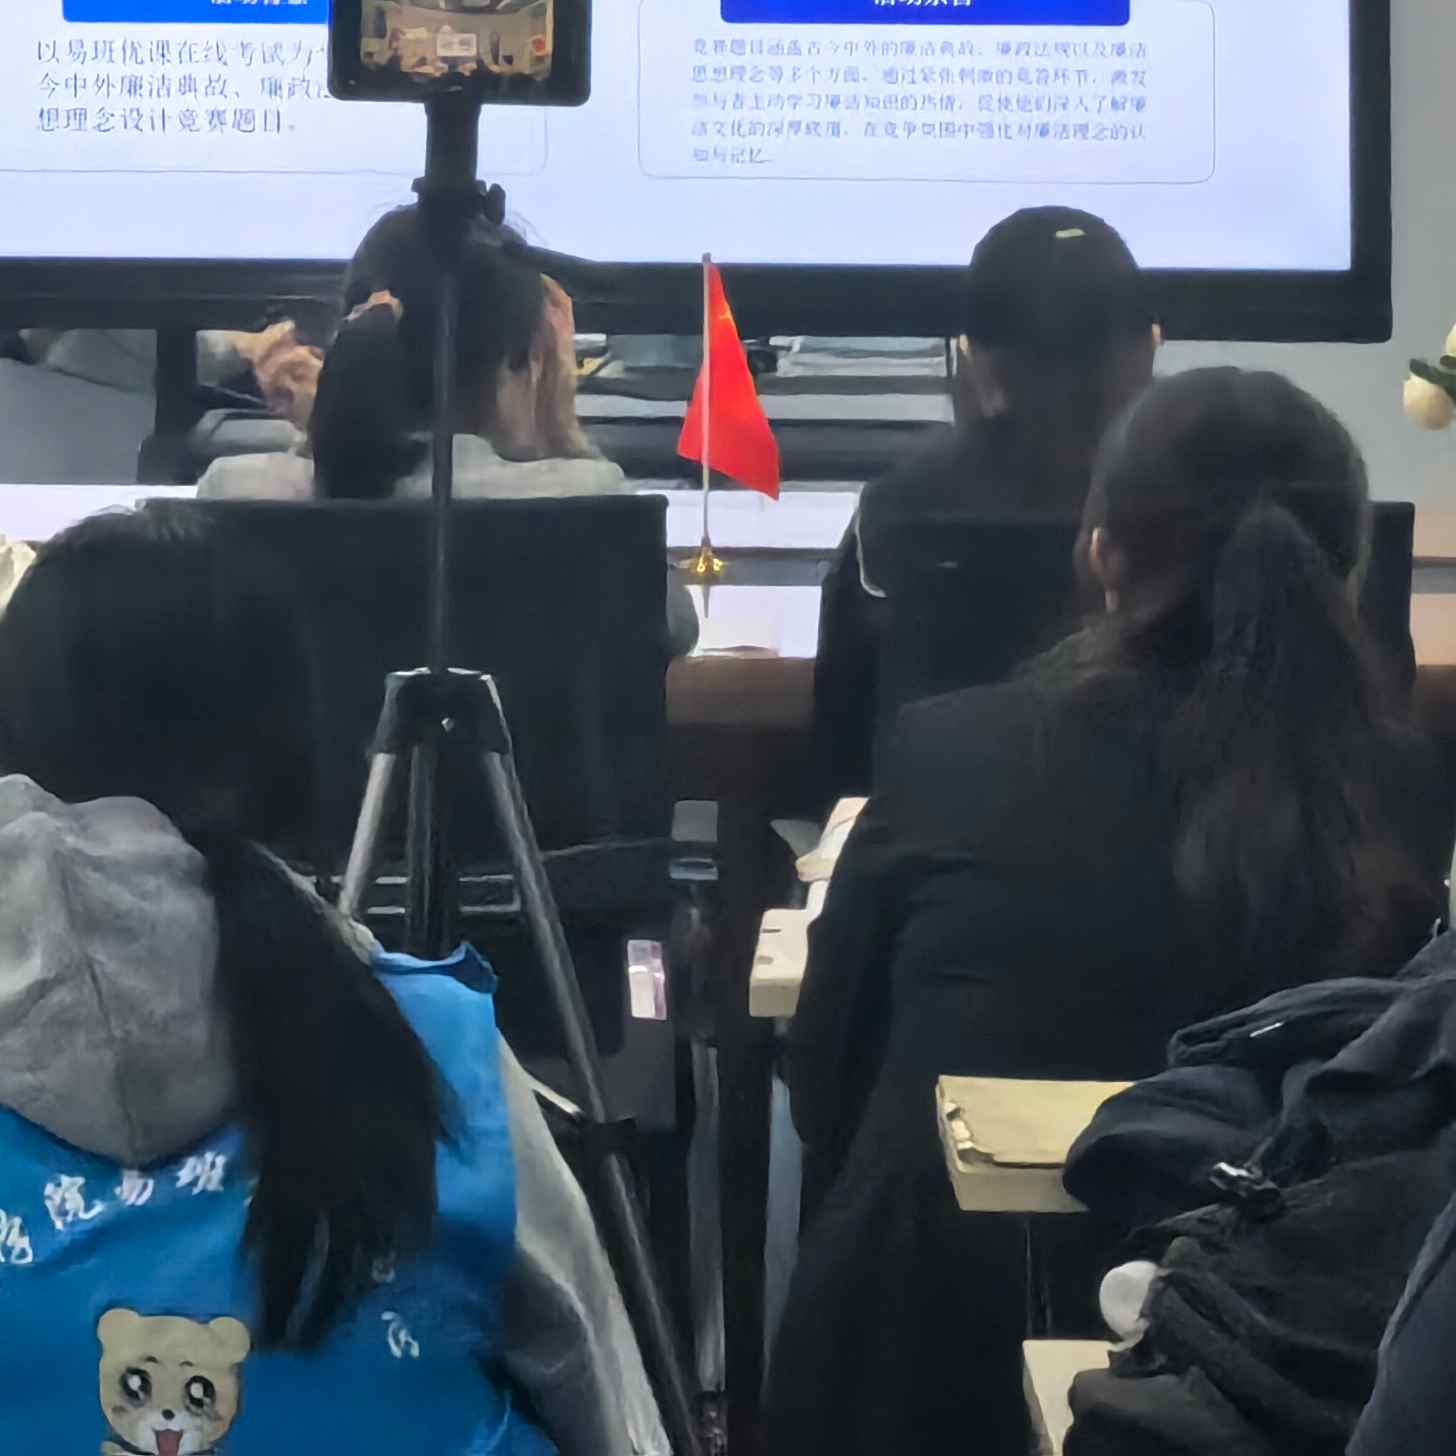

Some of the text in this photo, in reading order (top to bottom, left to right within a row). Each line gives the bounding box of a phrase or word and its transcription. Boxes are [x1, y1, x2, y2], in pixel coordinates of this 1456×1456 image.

[37, 39, 328, 67] 以易班优课在线考试为
